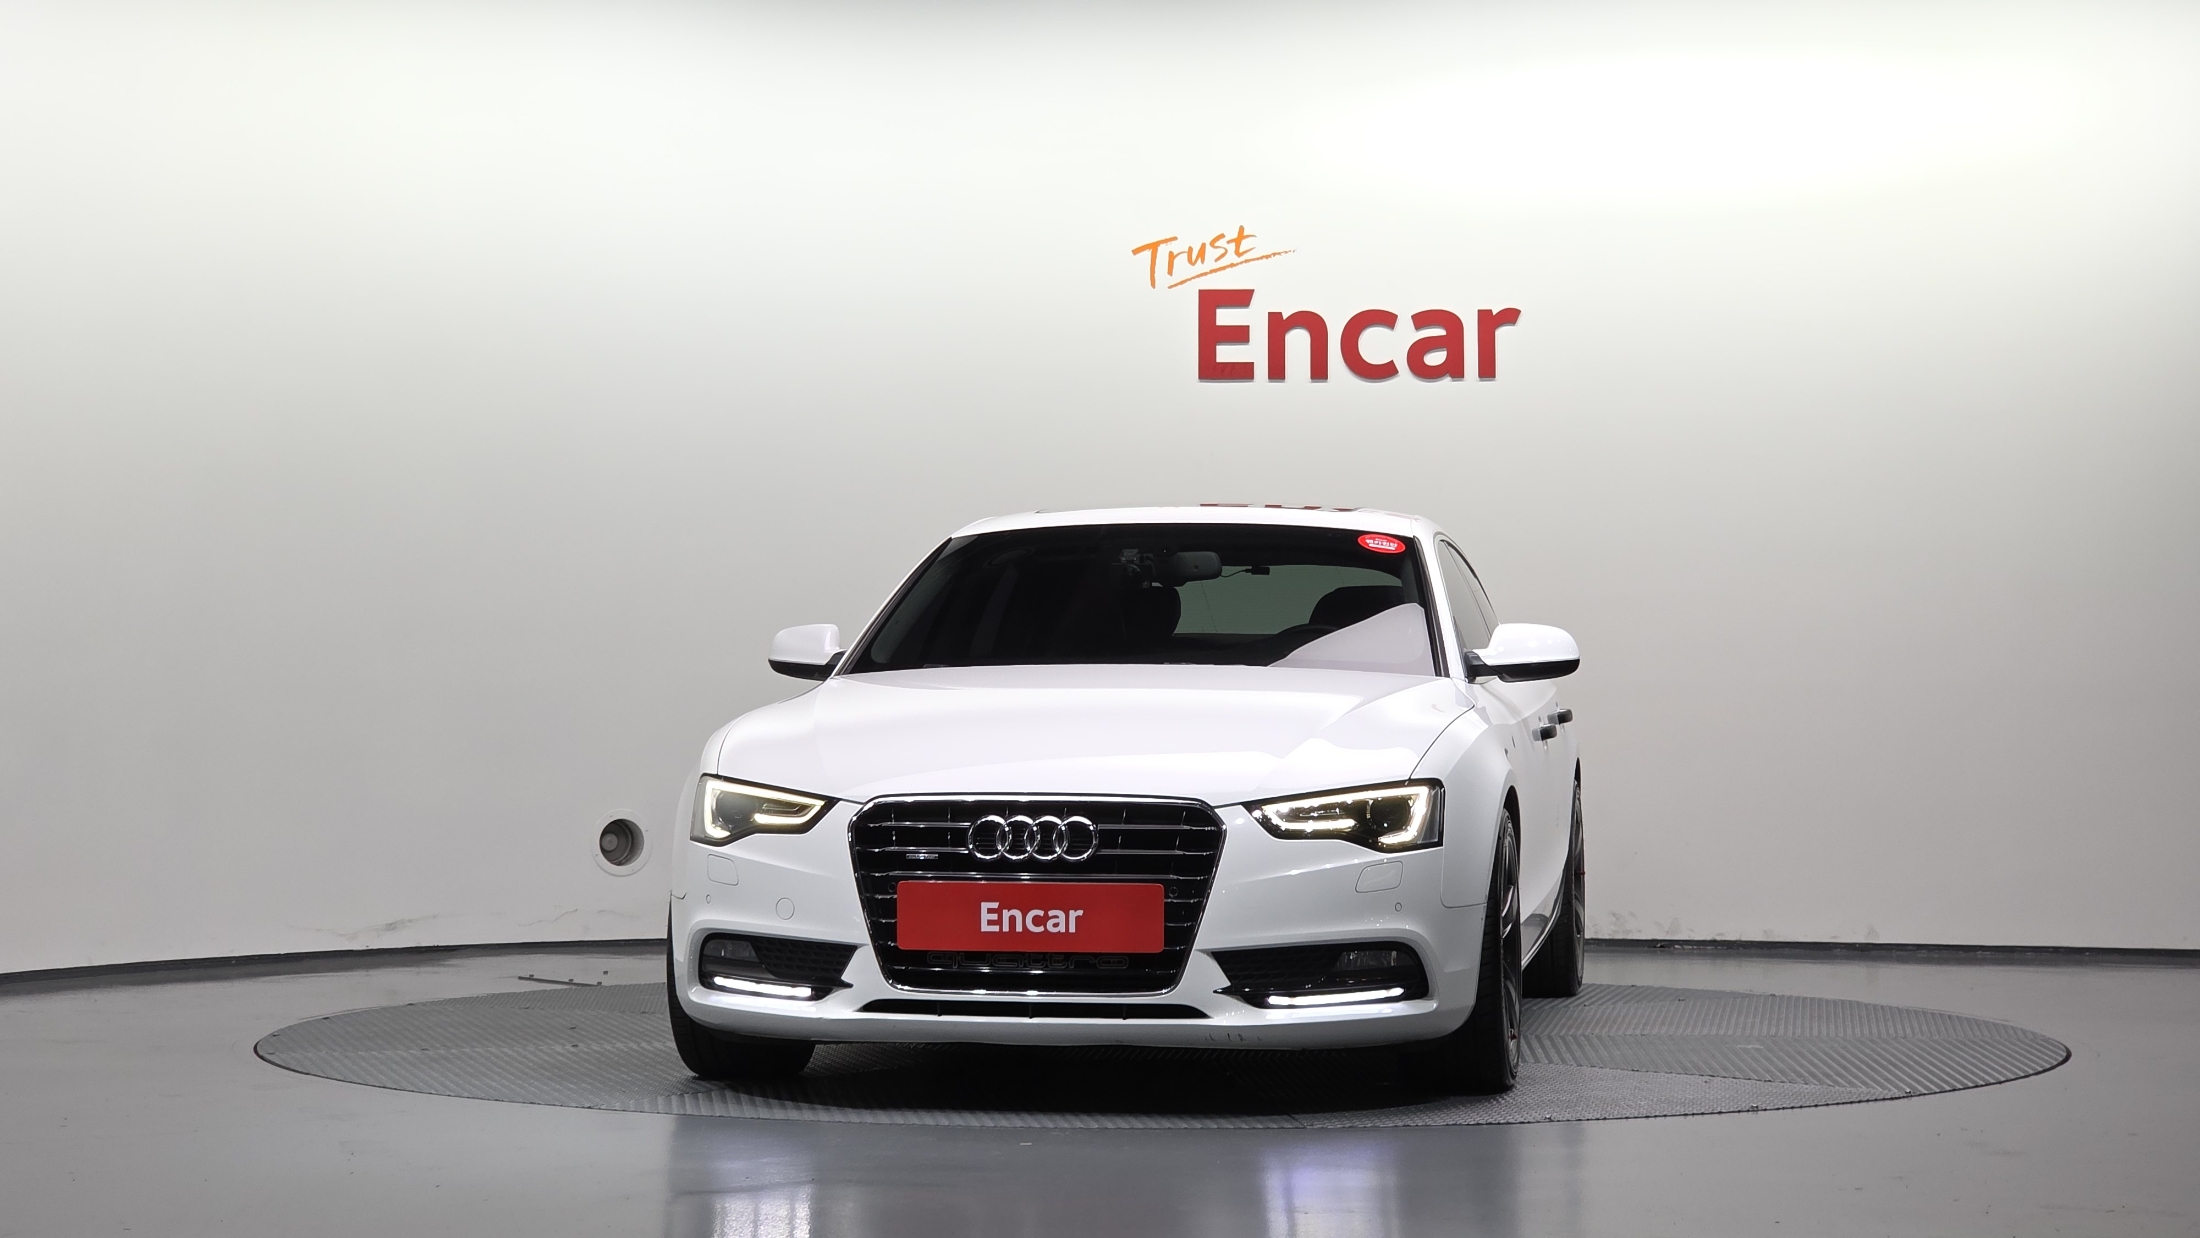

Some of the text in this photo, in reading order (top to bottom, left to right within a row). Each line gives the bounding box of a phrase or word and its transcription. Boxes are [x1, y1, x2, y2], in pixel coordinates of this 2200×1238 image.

[1132, 225, 1258, 289] Trust
[1198, 289, 1521, 380] Encar
[980, 901, 1083, 933] Encar
[926, 951, 1130, 969] quattro
